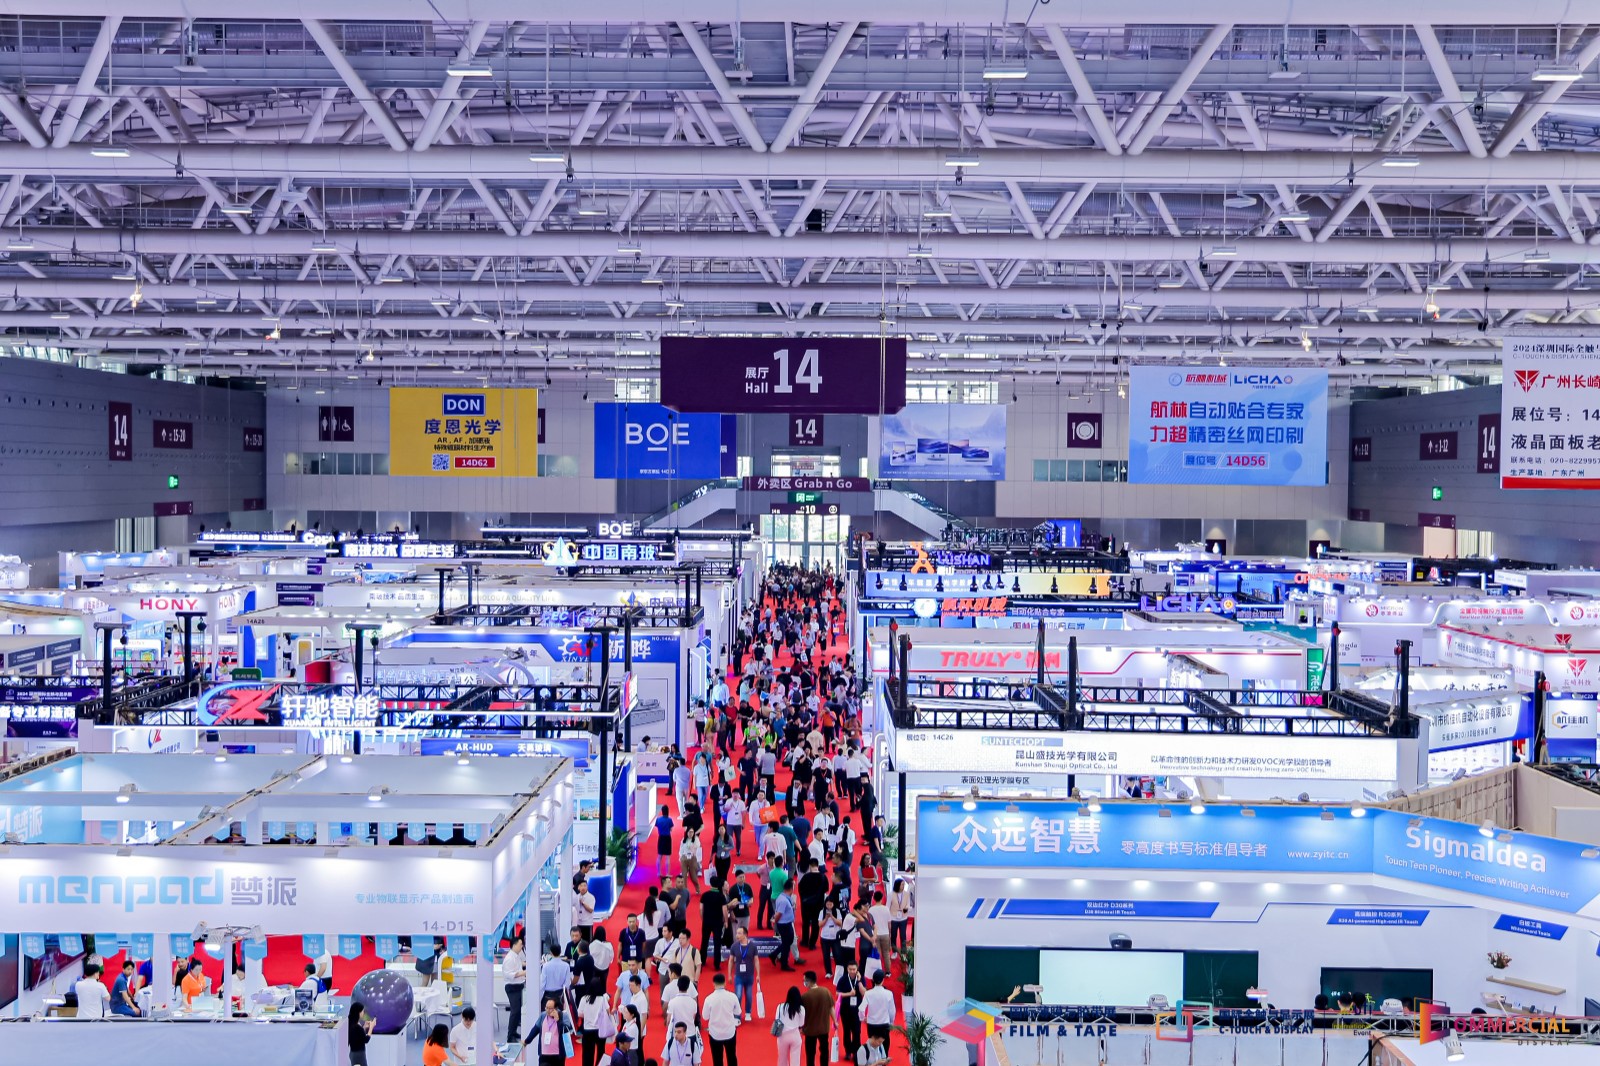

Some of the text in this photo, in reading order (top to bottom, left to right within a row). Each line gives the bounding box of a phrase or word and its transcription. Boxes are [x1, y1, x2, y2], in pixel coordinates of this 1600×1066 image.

[745, 348, 822, 394] Hall 14
[745, 366, 769, 378] 展厅
[446, 398, 480, 411] DON
[1150, 400, 1304, 420] 航林自动贴合专家
[114, 413, 128, 447] 14
[424, 418, 501, 435] 度恩光学
[625, 422, 690, 446] BOE
[796, 417, 818, 439] 14
[1150, 425, 1304, 444] 力超精密丝网印刷
[1482, 426, 1496, 459] 14
[1185, 455, 1216, 466] 展位号
[1226, 455, 1265, 466] 14D56
[757, 478, 852, 490] 外卖区 Grab n Go
[599, 523, 633, 536] BOE
[585, 543, 656, 561] 中国南玻
[140, 598, 199, 610] HONY
[940, 651, 1012, 668] TRULY
[281, 694, 379, 719] 轩驰智能
[455, 742, 494, 752] AR-HUD
[1016, 750, 1118, 763] 昆山盛技光学有限公司
[951, 815, 1102, 856] 众远智慧
[1120, 840, 1268, 858] 零高度书写标准倡导者
[1287, 849, 1350, 860] www.zyitc.cn
[1405, 825, 1547, 873] SigmaIdea
[1384, 855, 1409, 868] Touch
[1409, 859, 1428, 872] Tech
[1465, 869, 1496, 885] Precise
[1498, 875, 1529, 892] Writing
[1530, 882, 1570, 899] Achiever
[18, 867, 225, 913] menpad
[230, 876, 297, 906] 梦派
[354, 892, 475, 905] 专业物联显示产品制造商
[422, 920, 475, 932] 14-D15
